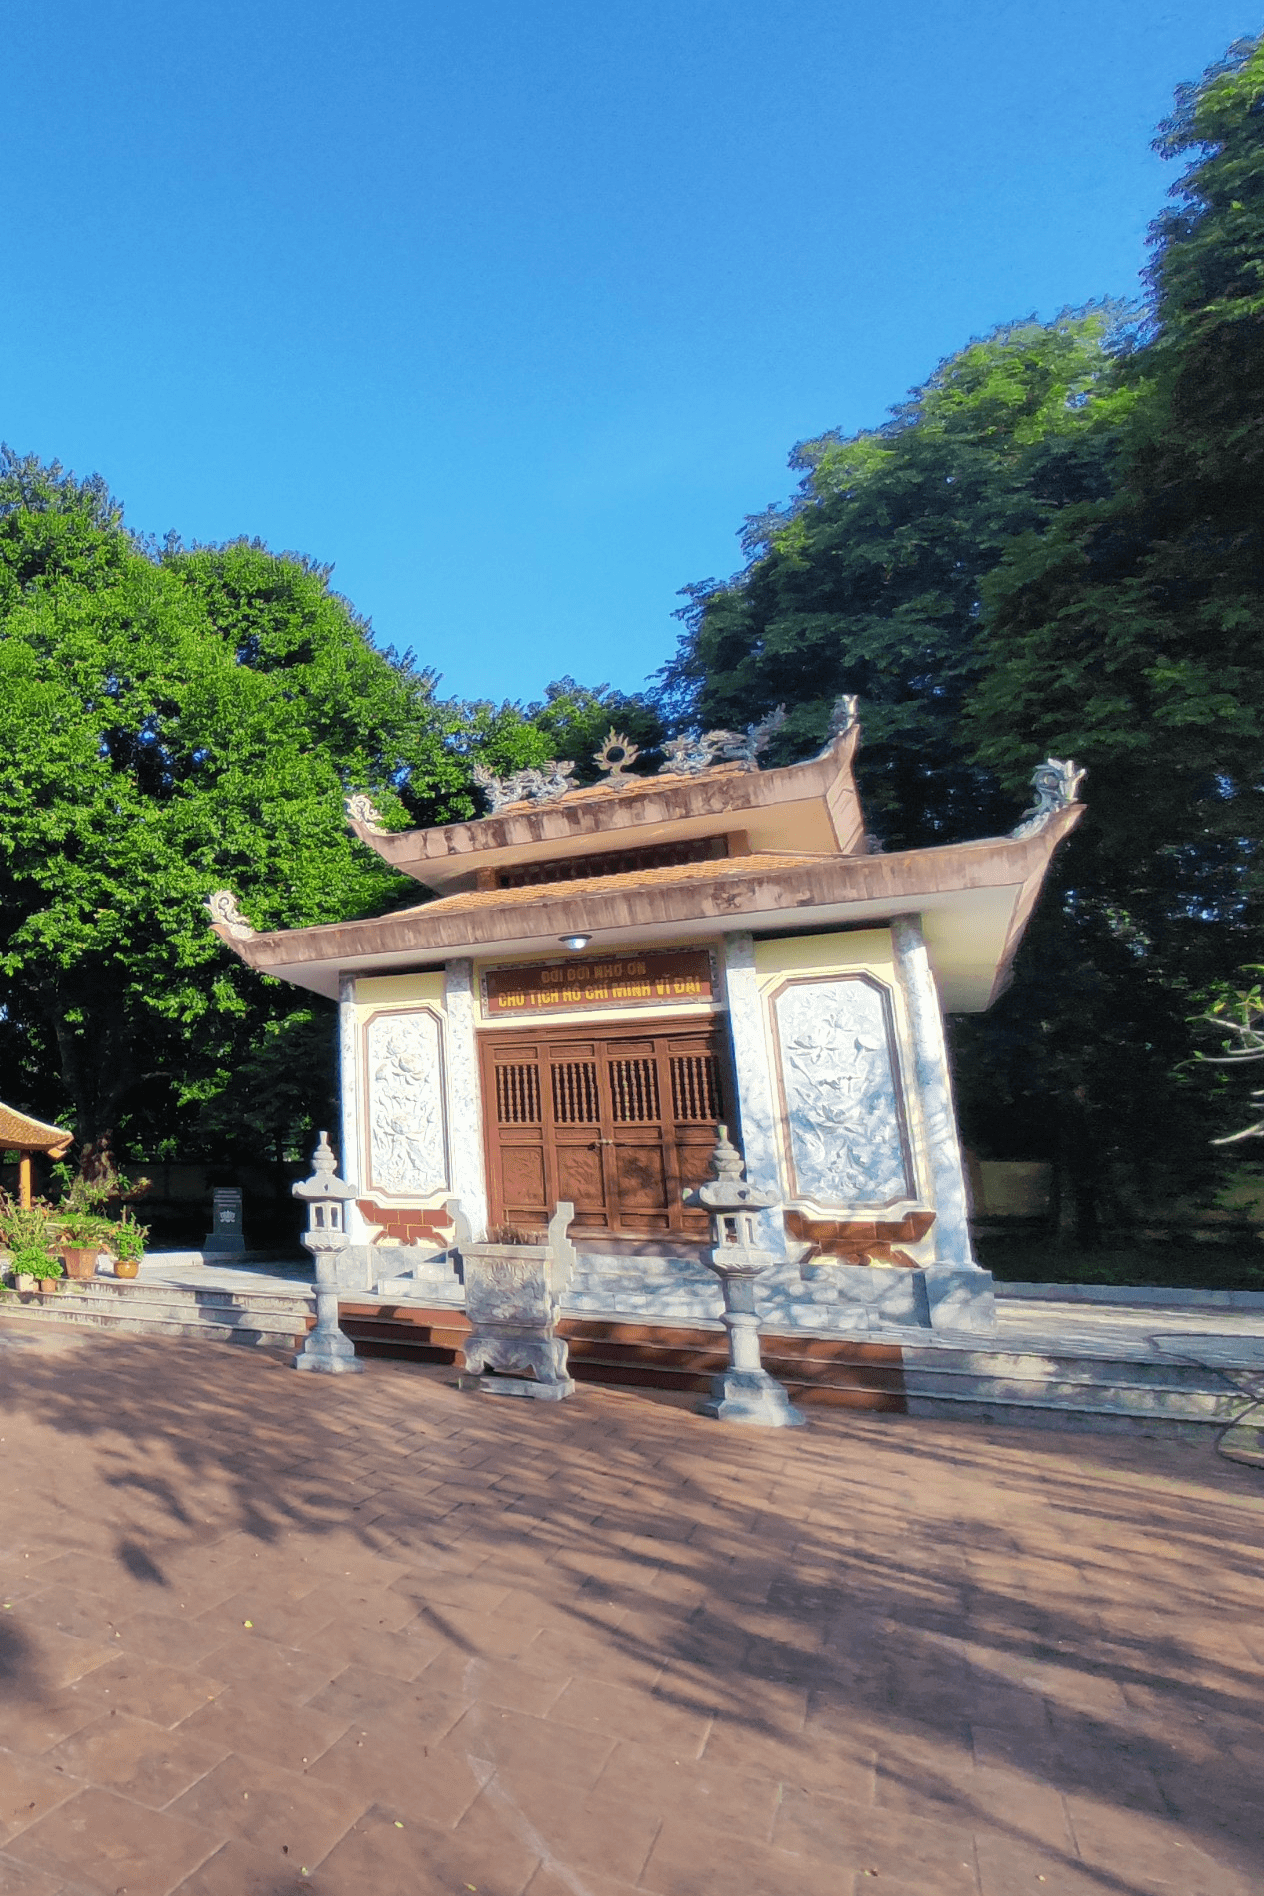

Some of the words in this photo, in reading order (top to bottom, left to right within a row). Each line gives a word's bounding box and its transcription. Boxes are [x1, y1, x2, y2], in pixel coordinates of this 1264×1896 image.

[529, 988, 559, 1007] TỊCH
[585, 980, 609, 1000] CHÍ
[612, 979, 652, 998] MINH
[655, 973, 671, 995] VĨ
[673, 975, 702, 995] ĐẠI
